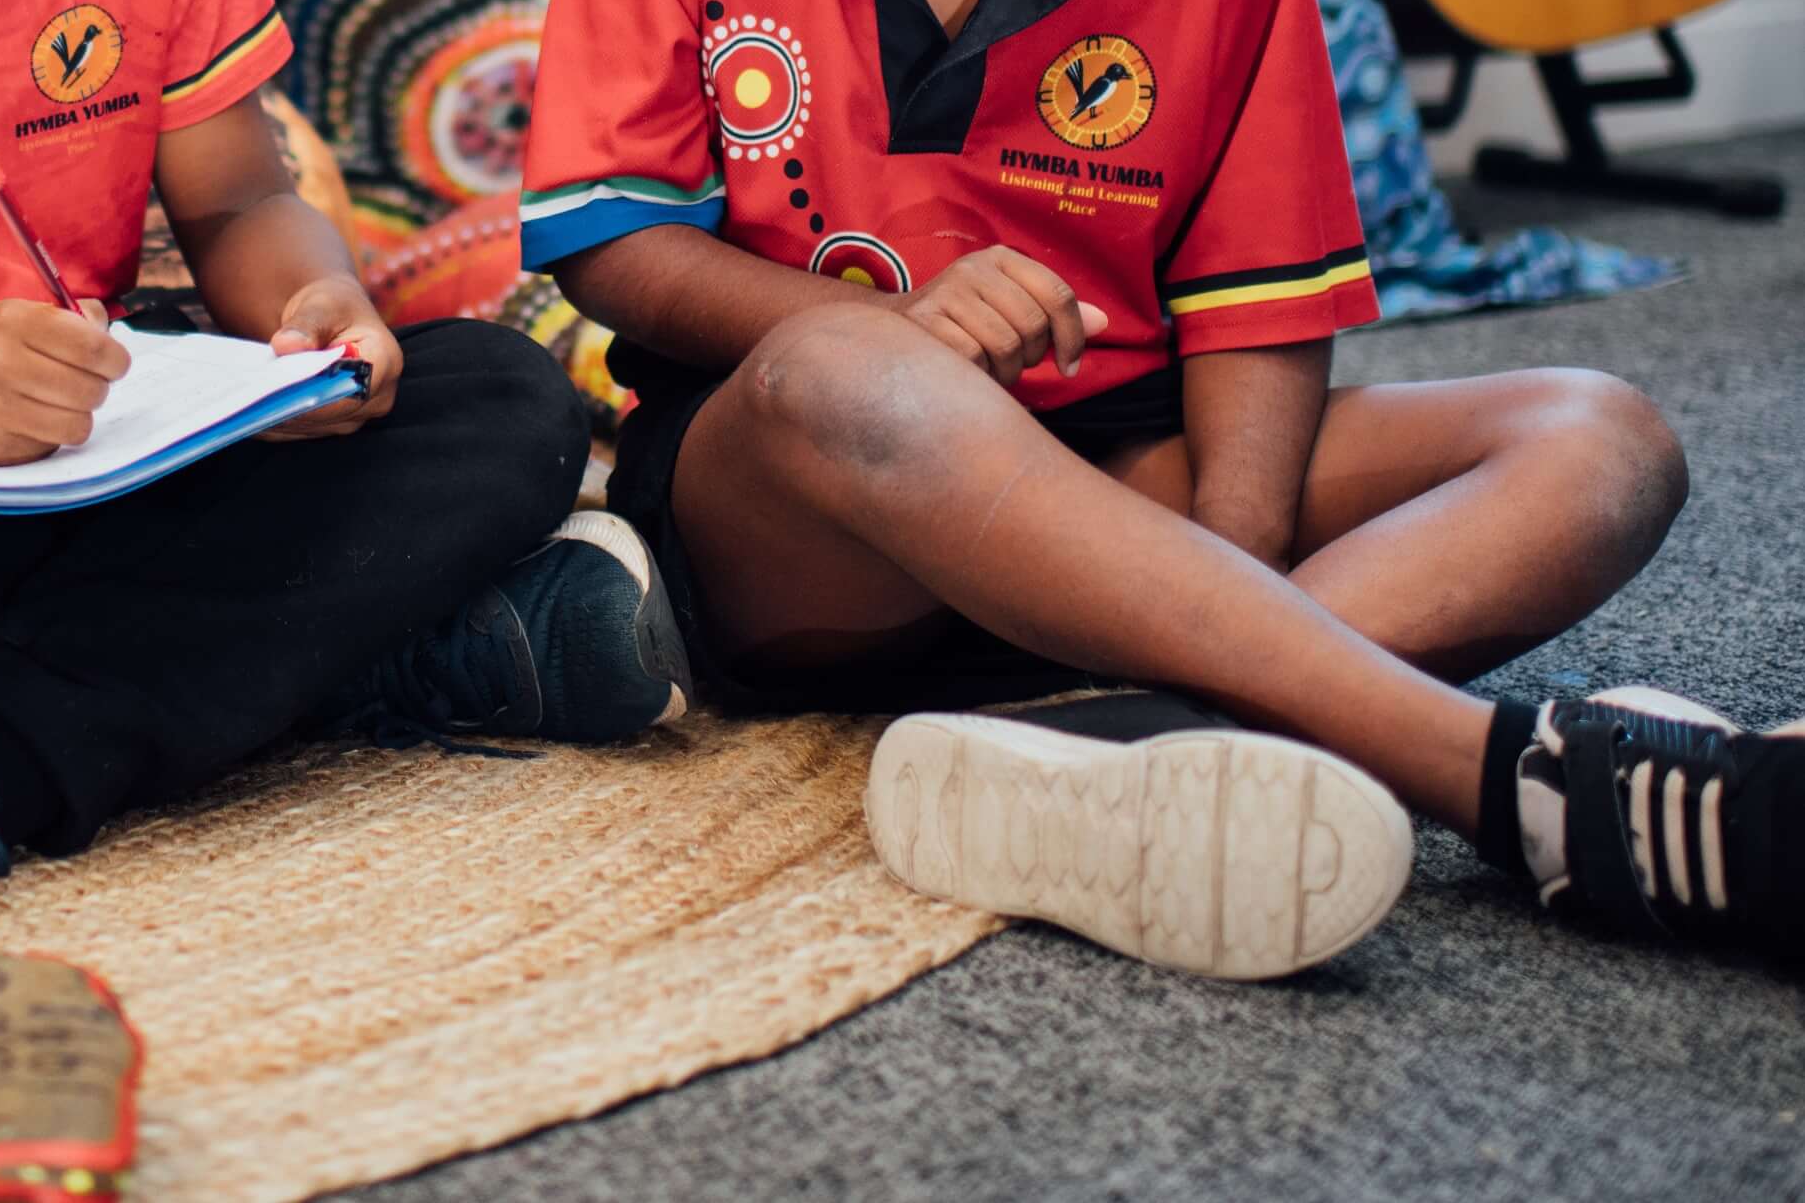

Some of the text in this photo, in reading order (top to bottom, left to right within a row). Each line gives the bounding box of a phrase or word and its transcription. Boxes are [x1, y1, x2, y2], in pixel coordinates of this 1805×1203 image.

[15, 92, 141, 138] HYMBA YUMBA
[1000, 148, 1165, 189] HYMBA YUMBA
[1000, 171, 1160, 209] Listening and Learning
[1058, 200, 1097, 217] Place
